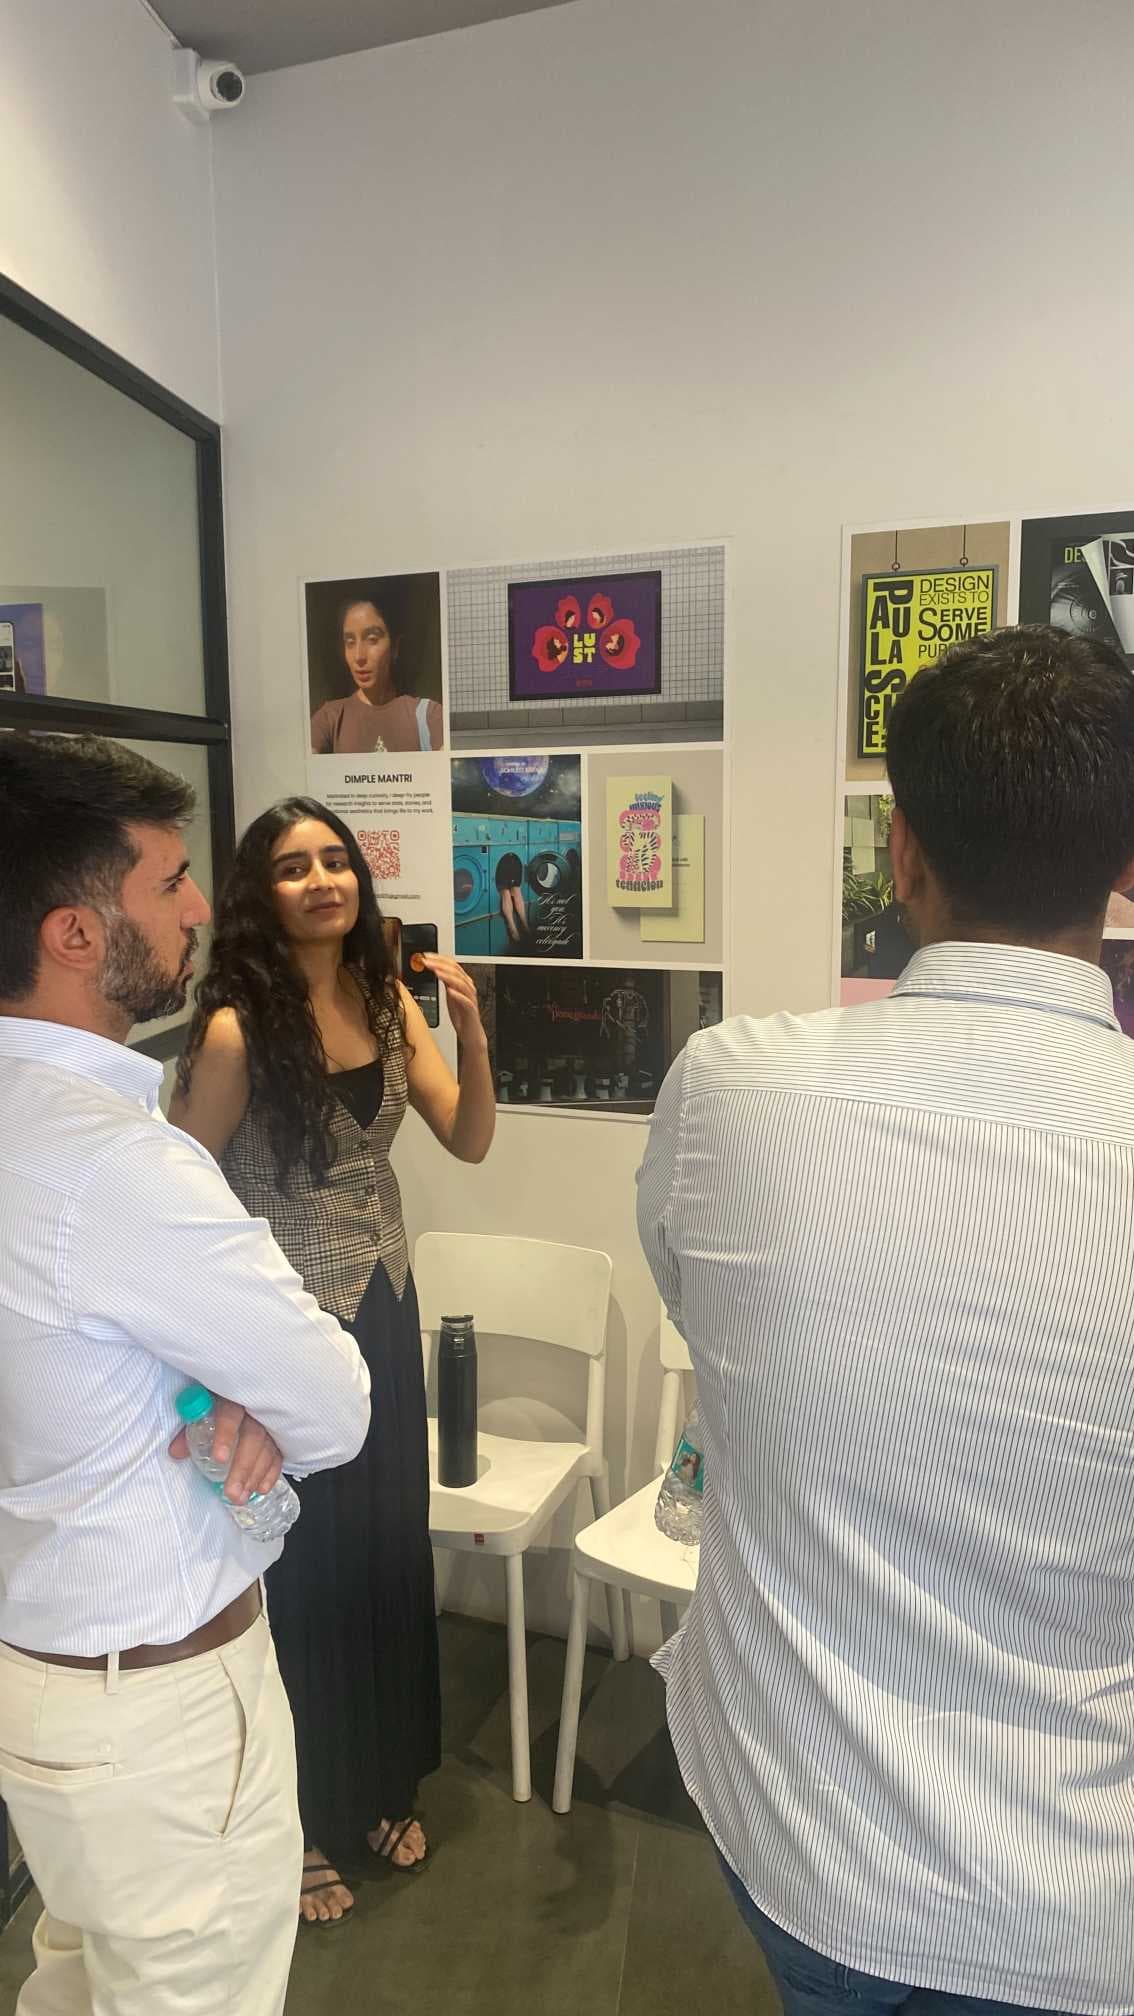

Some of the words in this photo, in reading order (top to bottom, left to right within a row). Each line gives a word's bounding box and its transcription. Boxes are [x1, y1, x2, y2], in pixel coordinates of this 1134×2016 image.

[1064, 546, 1086, 564] DE
[919, 575, 990, 594] DESIGN
[919, 592, 967, 606] EXISTS
[971, 590, 990, 604] TO
[344, 774, 376, 784] DIMPLE
[377, 773, 413, 784] MANTRI
